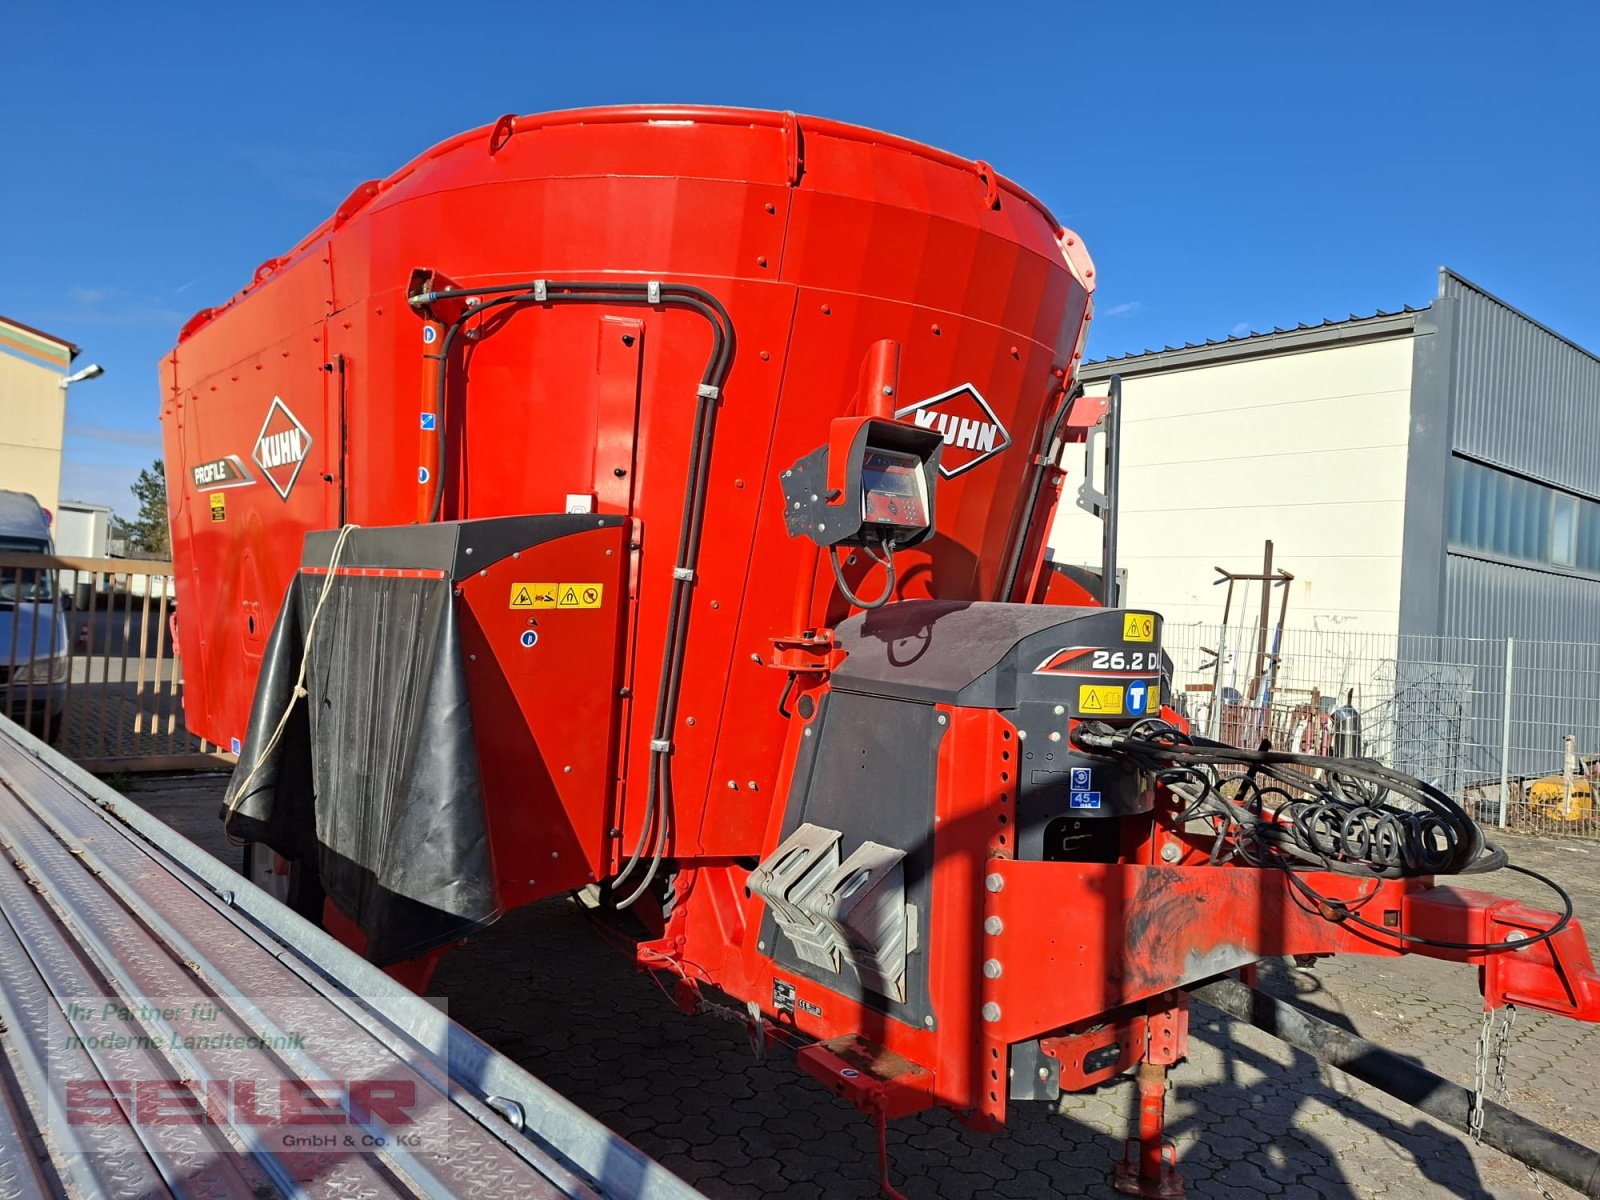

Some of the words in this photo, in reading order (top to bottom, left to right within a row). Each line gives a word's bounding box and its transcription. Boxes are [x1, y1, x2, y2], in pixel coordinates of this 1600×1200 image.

[914, 408, 997, 453] KUHN
[260, 427, 302, 469] KUHN
[194, 460, 226, 485] PROFILE
[1092, 650, 1143, 670] 26.2
[1130, 687, 1145, 710] T
[1074, 793, 1090, 803] 45
